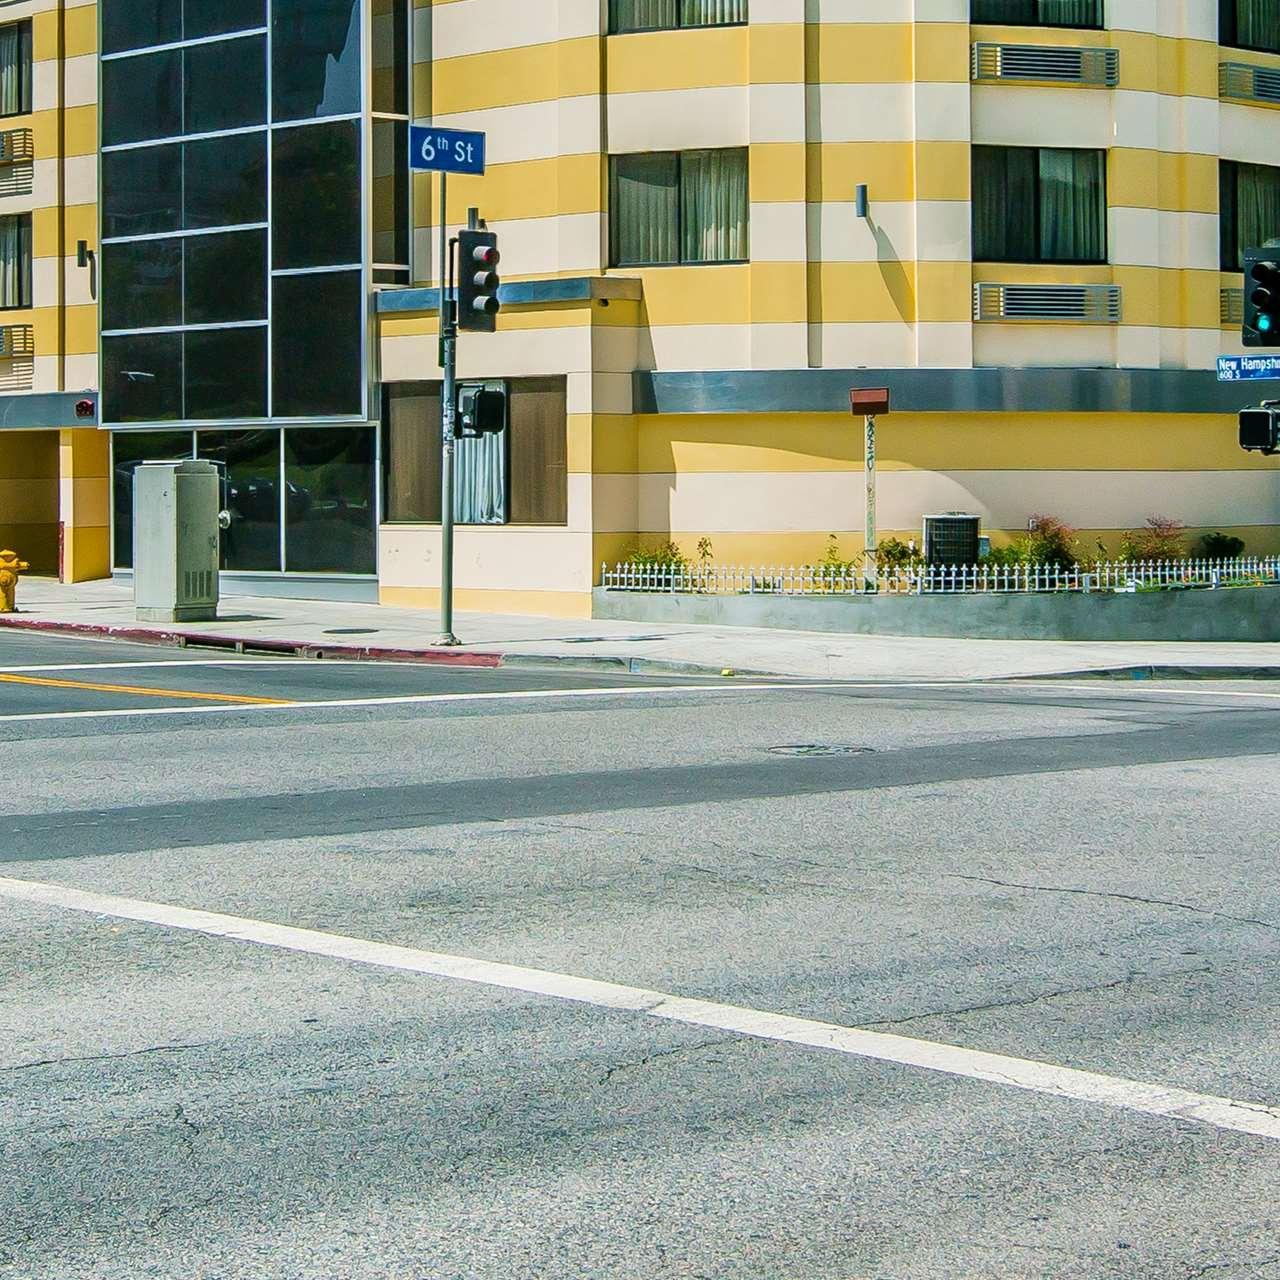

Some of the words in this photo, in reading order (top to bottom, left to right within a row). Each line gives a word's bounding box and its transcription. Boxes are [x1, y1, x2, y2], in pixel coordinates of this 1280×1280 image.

[421, 135, 448, 161] 6th
[454, 141, 473, 163] St
[1219, 358, 1237, 370] New
[1220, 370, 1233, 379] 600
